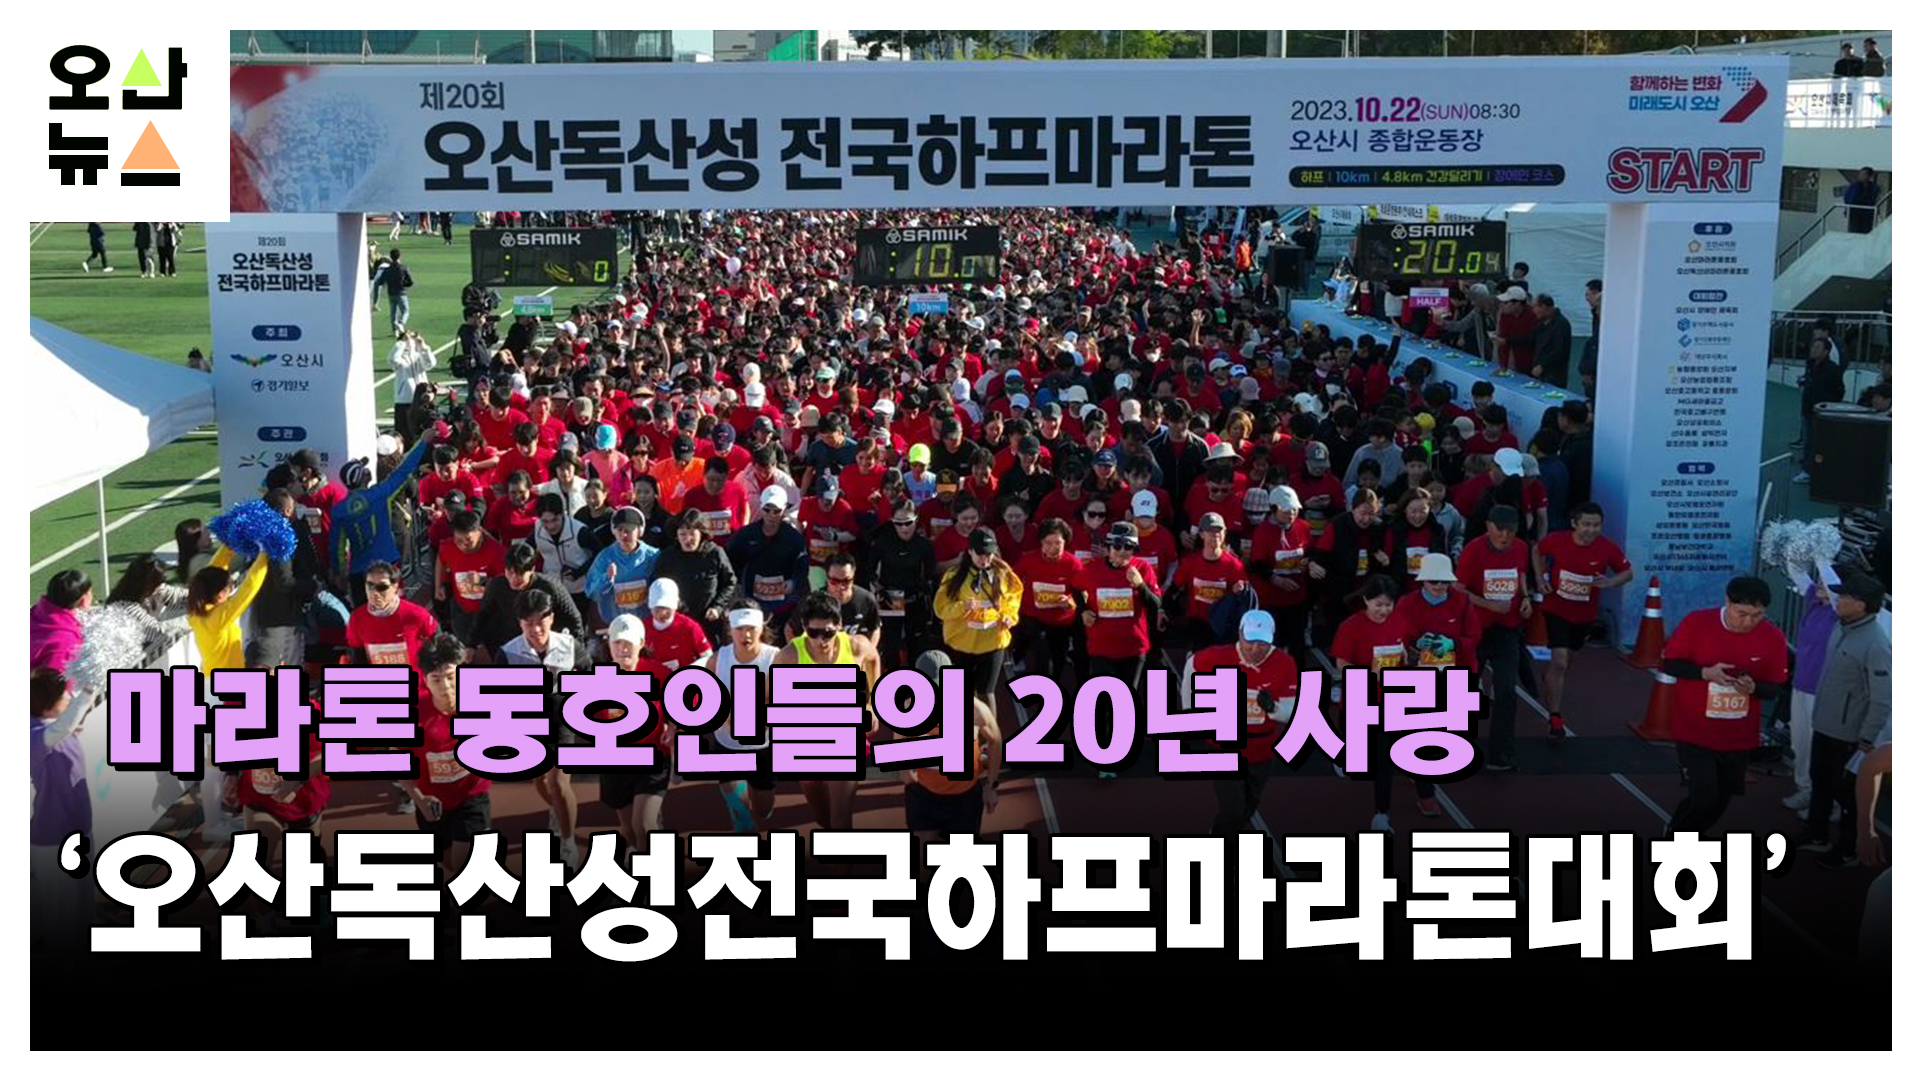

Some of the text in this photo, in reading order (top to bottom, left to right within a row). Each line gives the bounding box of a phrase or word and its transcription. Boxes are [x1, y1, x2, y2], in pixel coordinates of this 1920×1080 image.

[1630, 75, 1722, 91] 함께하는 변화
[419, 81, 504, 110] 제20회
[1629, 94, 1720, 111] 미래도시 오산
[1291, 97, 1521, 123] 2023.10.22(SUN)08:30
[1290, 129, 1483, 152] 오산시 종합운동장
[423, 114, 1254, 193] 오산독산성 전국하프마라톤
[1301, 170, 1324, 183] 하프
[1336, 171, 1370, 183] 10km
[1381, 171, 1424, 183] 4.8km
[1426, 169, 1482, 183] 건강달리기
[1533, 169, 1555, 181] 코스
[1607, 147, 1765, 193] START
[903, 229, 968, 242] SAMIK
[1408, 224, 1475, 238] SAMIK
[257, 236, 286, 247] 제20회
[517, 233, 581, 246] SAMIK
[232, 253, 314, 271] 오산독산성
[217, 274, 331, 292] 전국하프마라톤
[281, 354, 324, 367] 오산시
[267, 380, 310, 392] 경기일보
[1486, 581, 1516, 591] 6028
[1560, 580, 1589, 595] 5990
[1711, 696, 1746, 709] 5167
